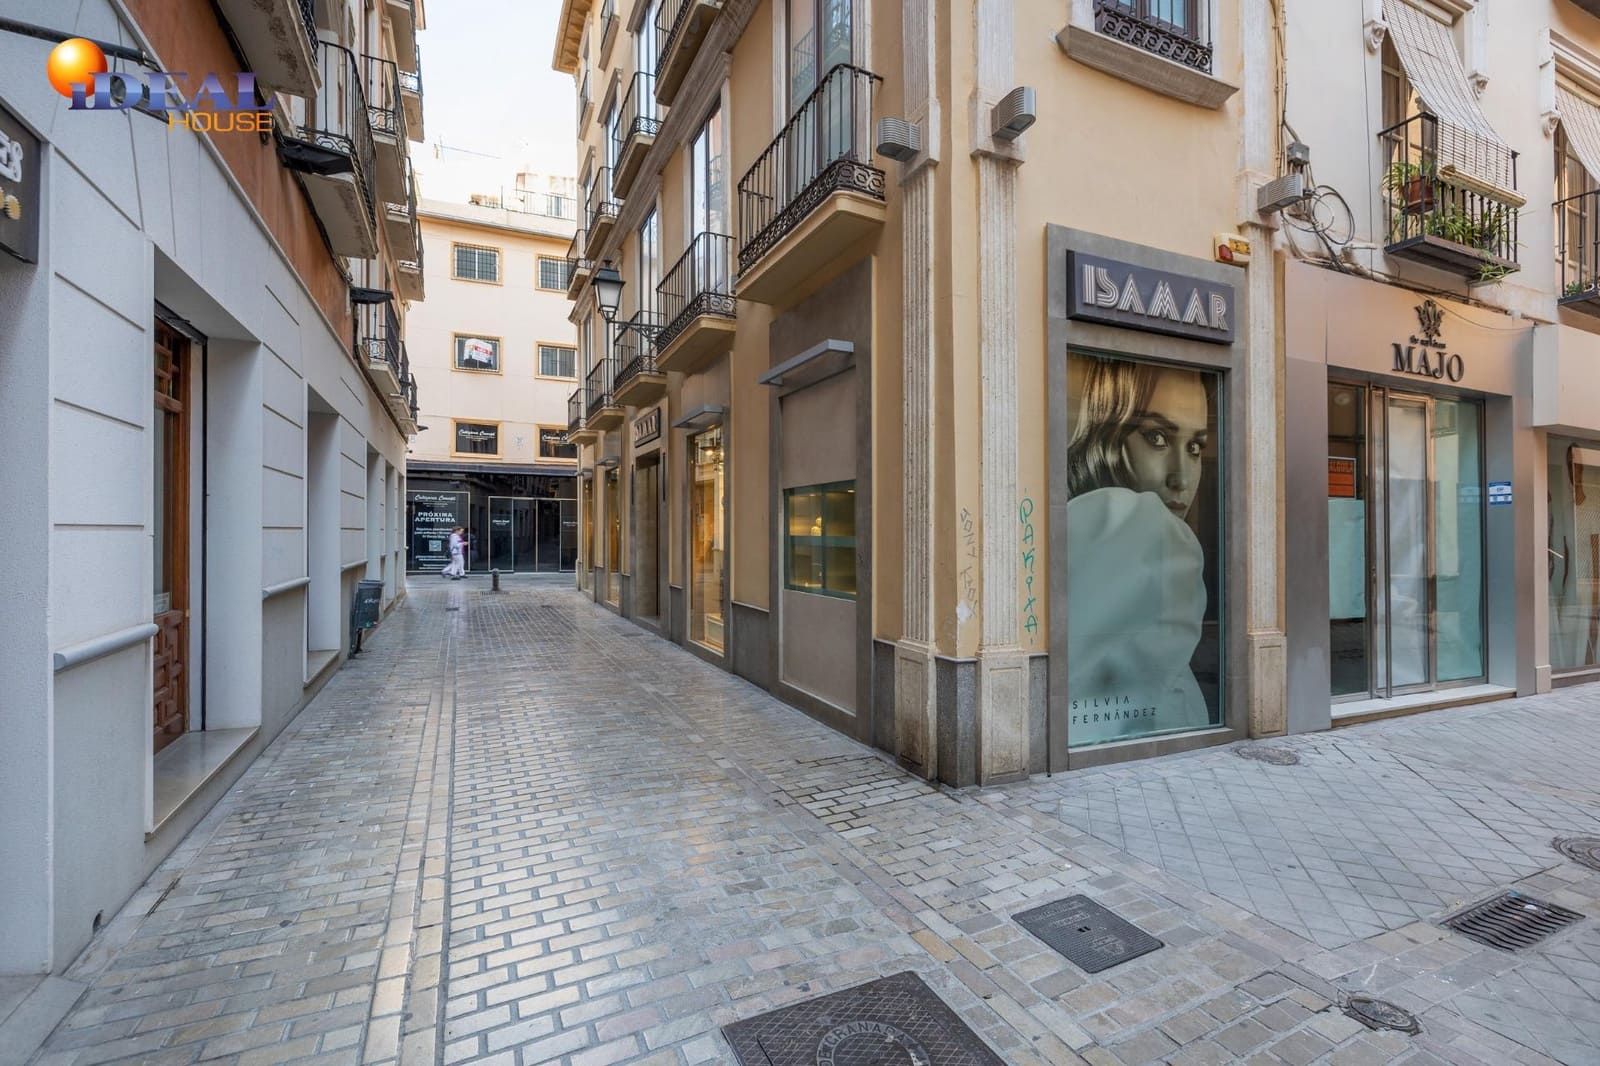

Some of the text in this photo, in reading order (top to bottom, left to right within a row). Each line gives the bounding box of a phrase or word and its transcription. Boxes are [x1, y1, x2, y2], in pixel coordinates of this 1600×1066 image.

[1082, 264, 1231, 332] ISAMAR
[1391, 342, 1465, 382] MAJO
[1072, 695, 1130, 709] SILVIA
[1072, 706, 1157, 725] FERNÁNDEZ
